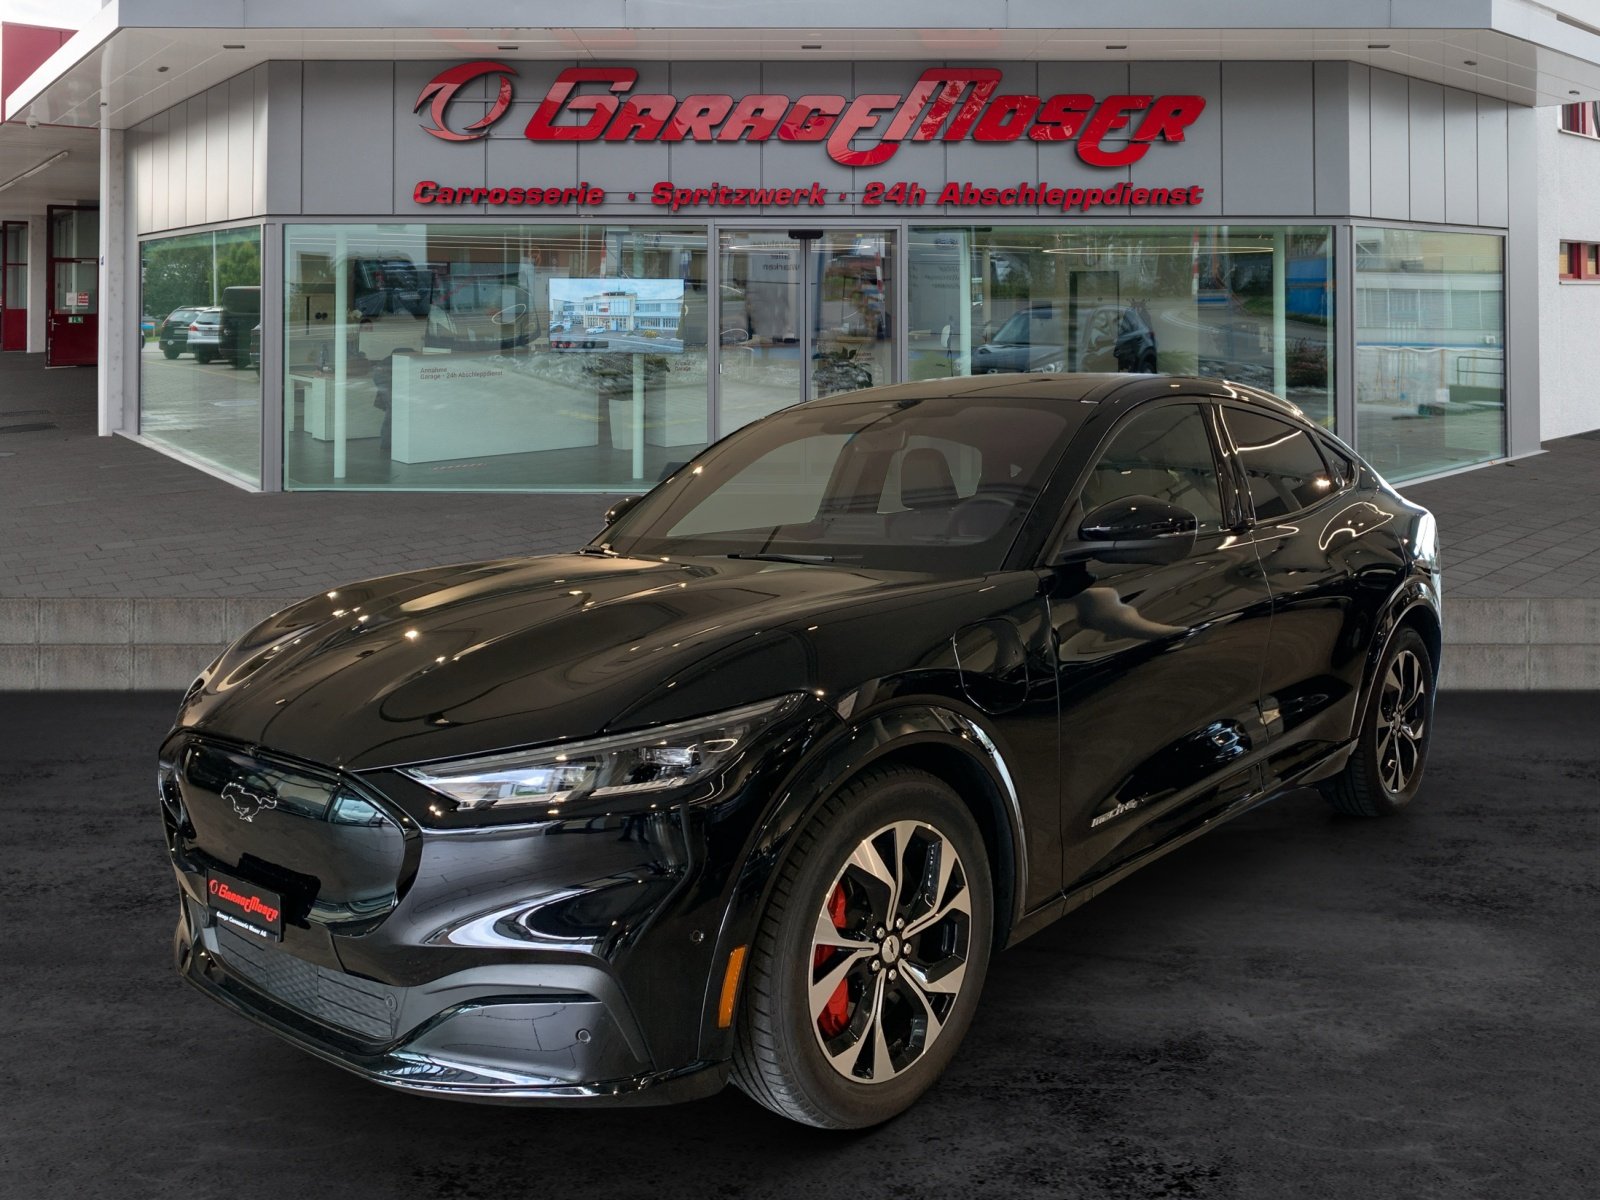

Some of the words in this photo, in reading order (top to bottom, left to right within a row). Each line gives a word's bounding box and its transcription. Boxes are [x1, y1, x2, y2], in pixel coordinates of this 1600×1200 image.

[413, 181, 604, 205] Carrosserie
[651, 181, 827, 211] Spritzwerk
[862, 182, 926, 206] 24h
[936, 182, 1204, 211] Abschleppdienst
[458, 370, 503, 378] Abschleppdienst
